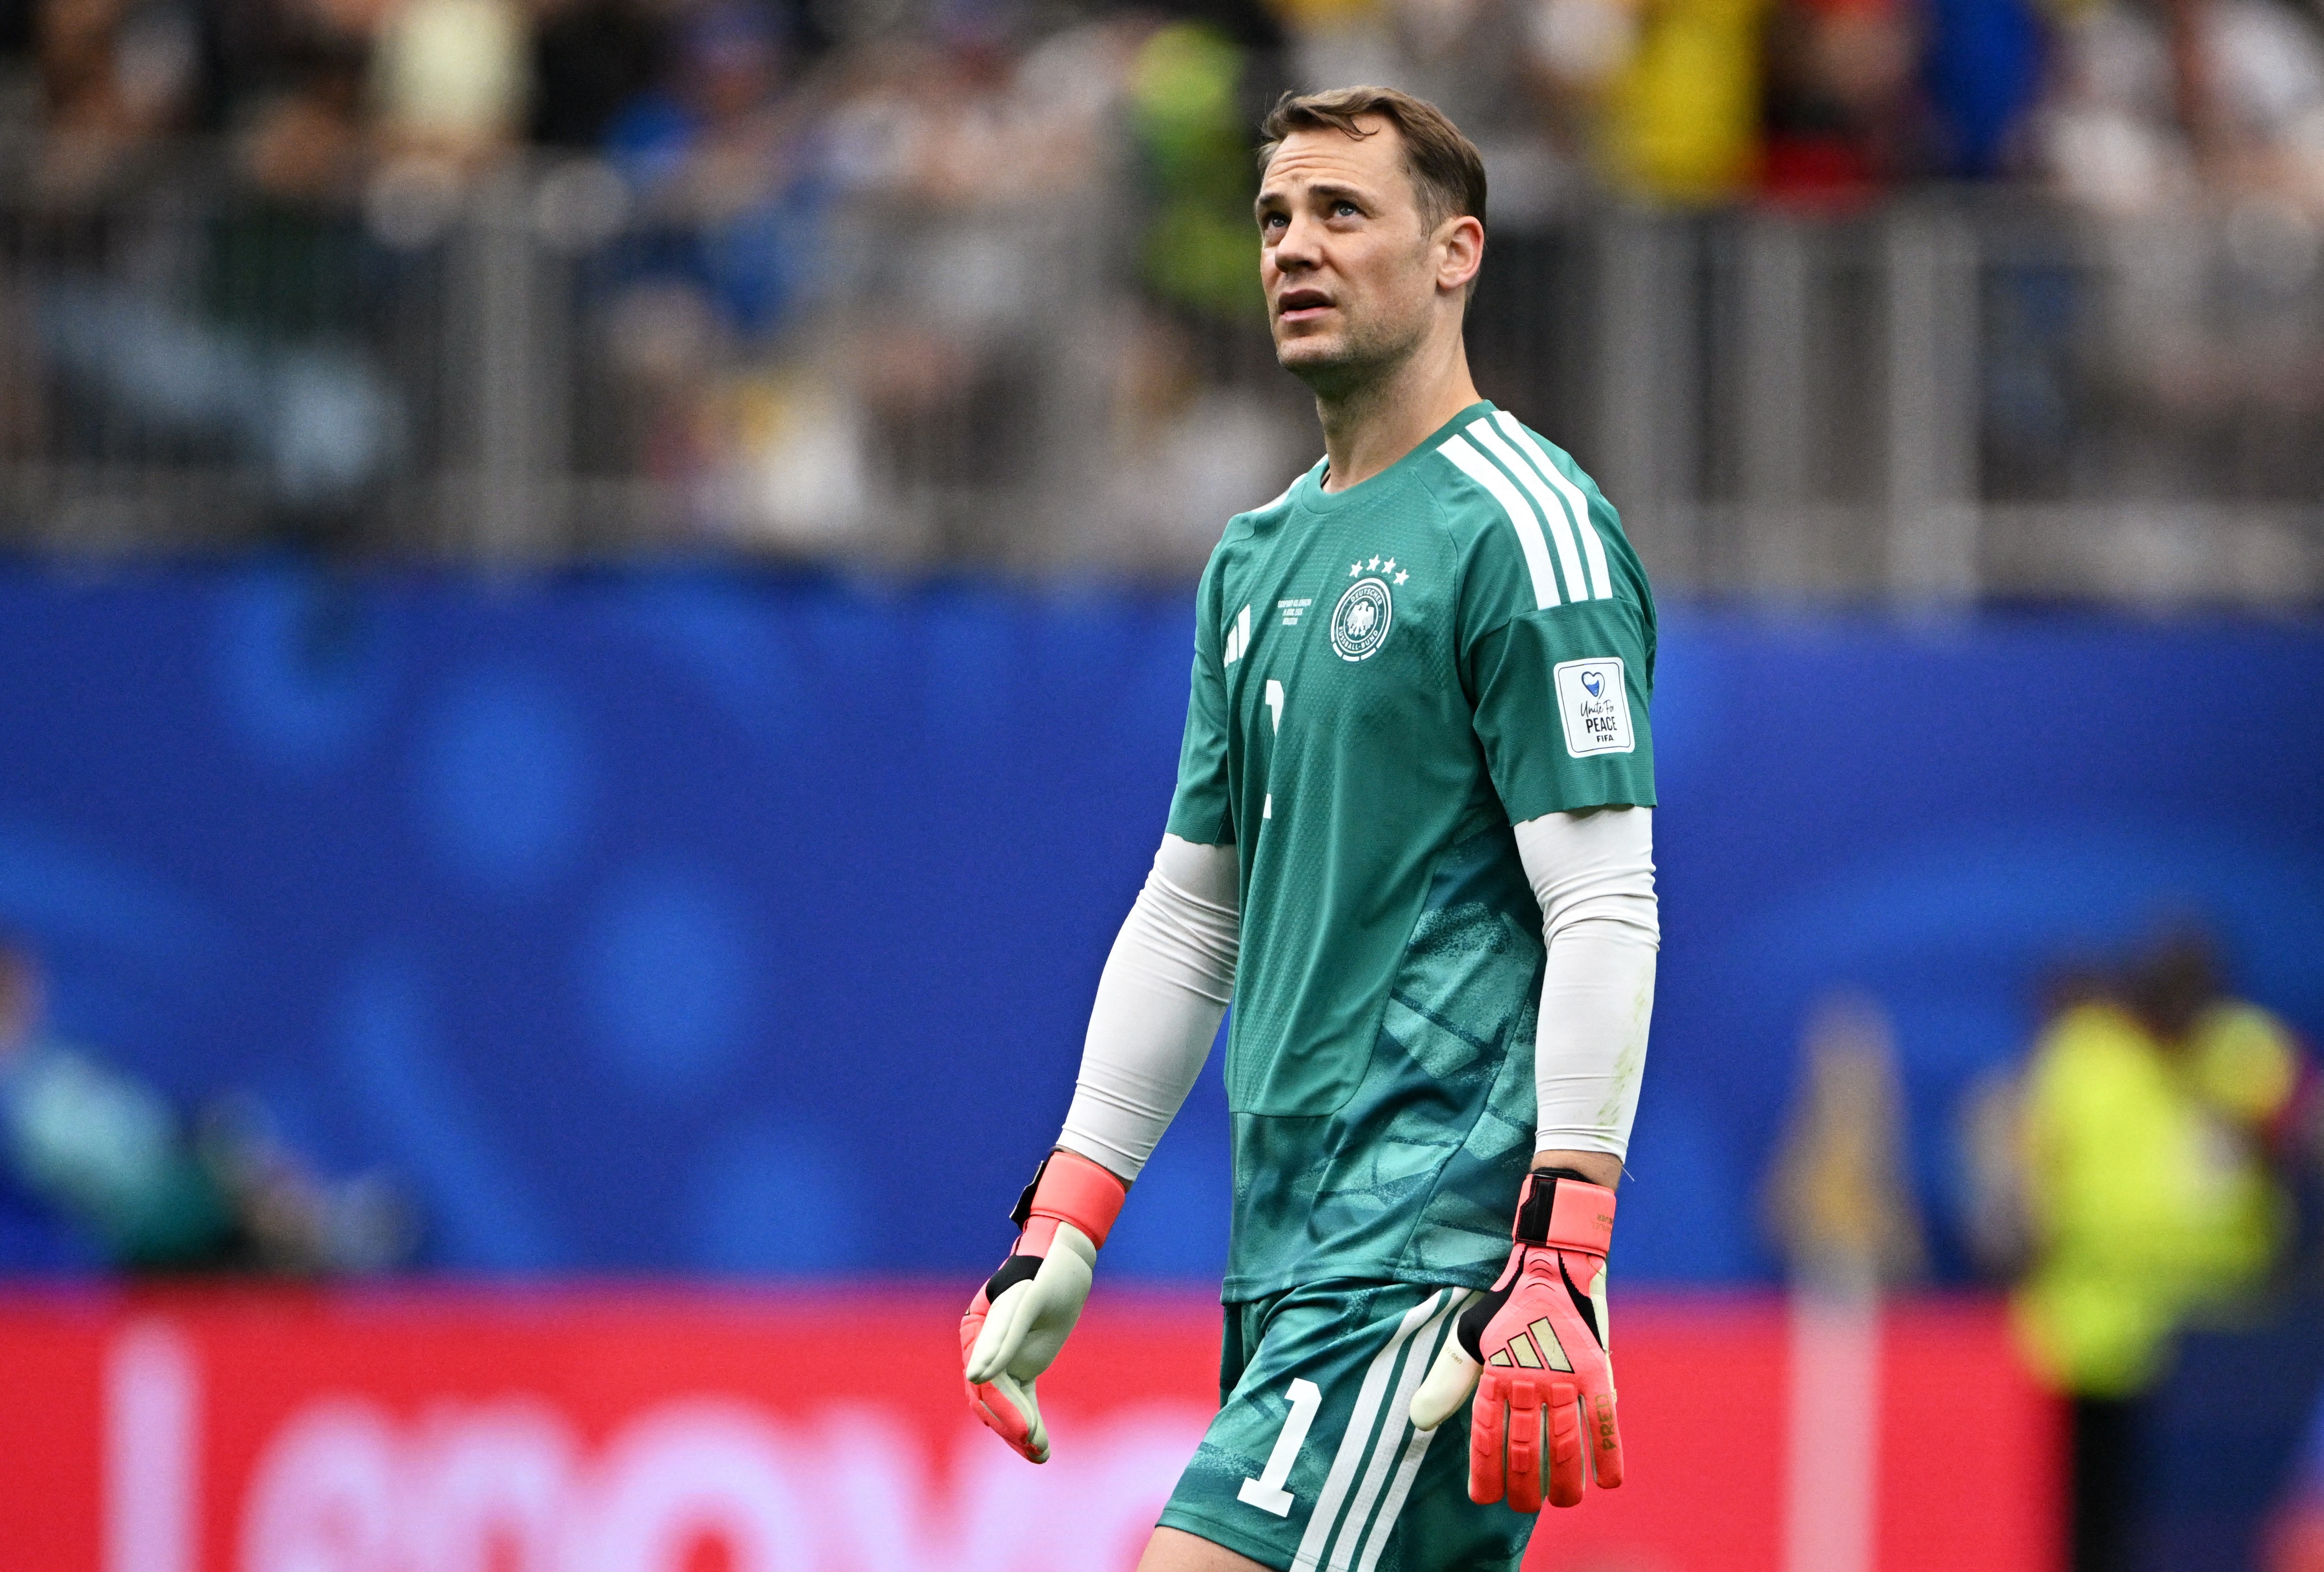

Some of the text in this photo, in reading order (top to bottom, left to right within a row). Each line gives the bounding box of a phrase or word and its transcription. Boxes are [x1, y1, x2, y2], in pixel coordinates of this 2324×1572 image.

[1350, 589, 1383, 606] DEUTSCHER
[1338, 625, 1379, 651] FUSSBALL-BUND
[1581, 699, 1614, 718] Unite For
[1586, 716, 1617, 733] PEACE
[1596, 734, 1614, 742] FIFA
[1595, 1395, 1617, 1450] PRED
[1237, 1378, 1322, 1518] 1
